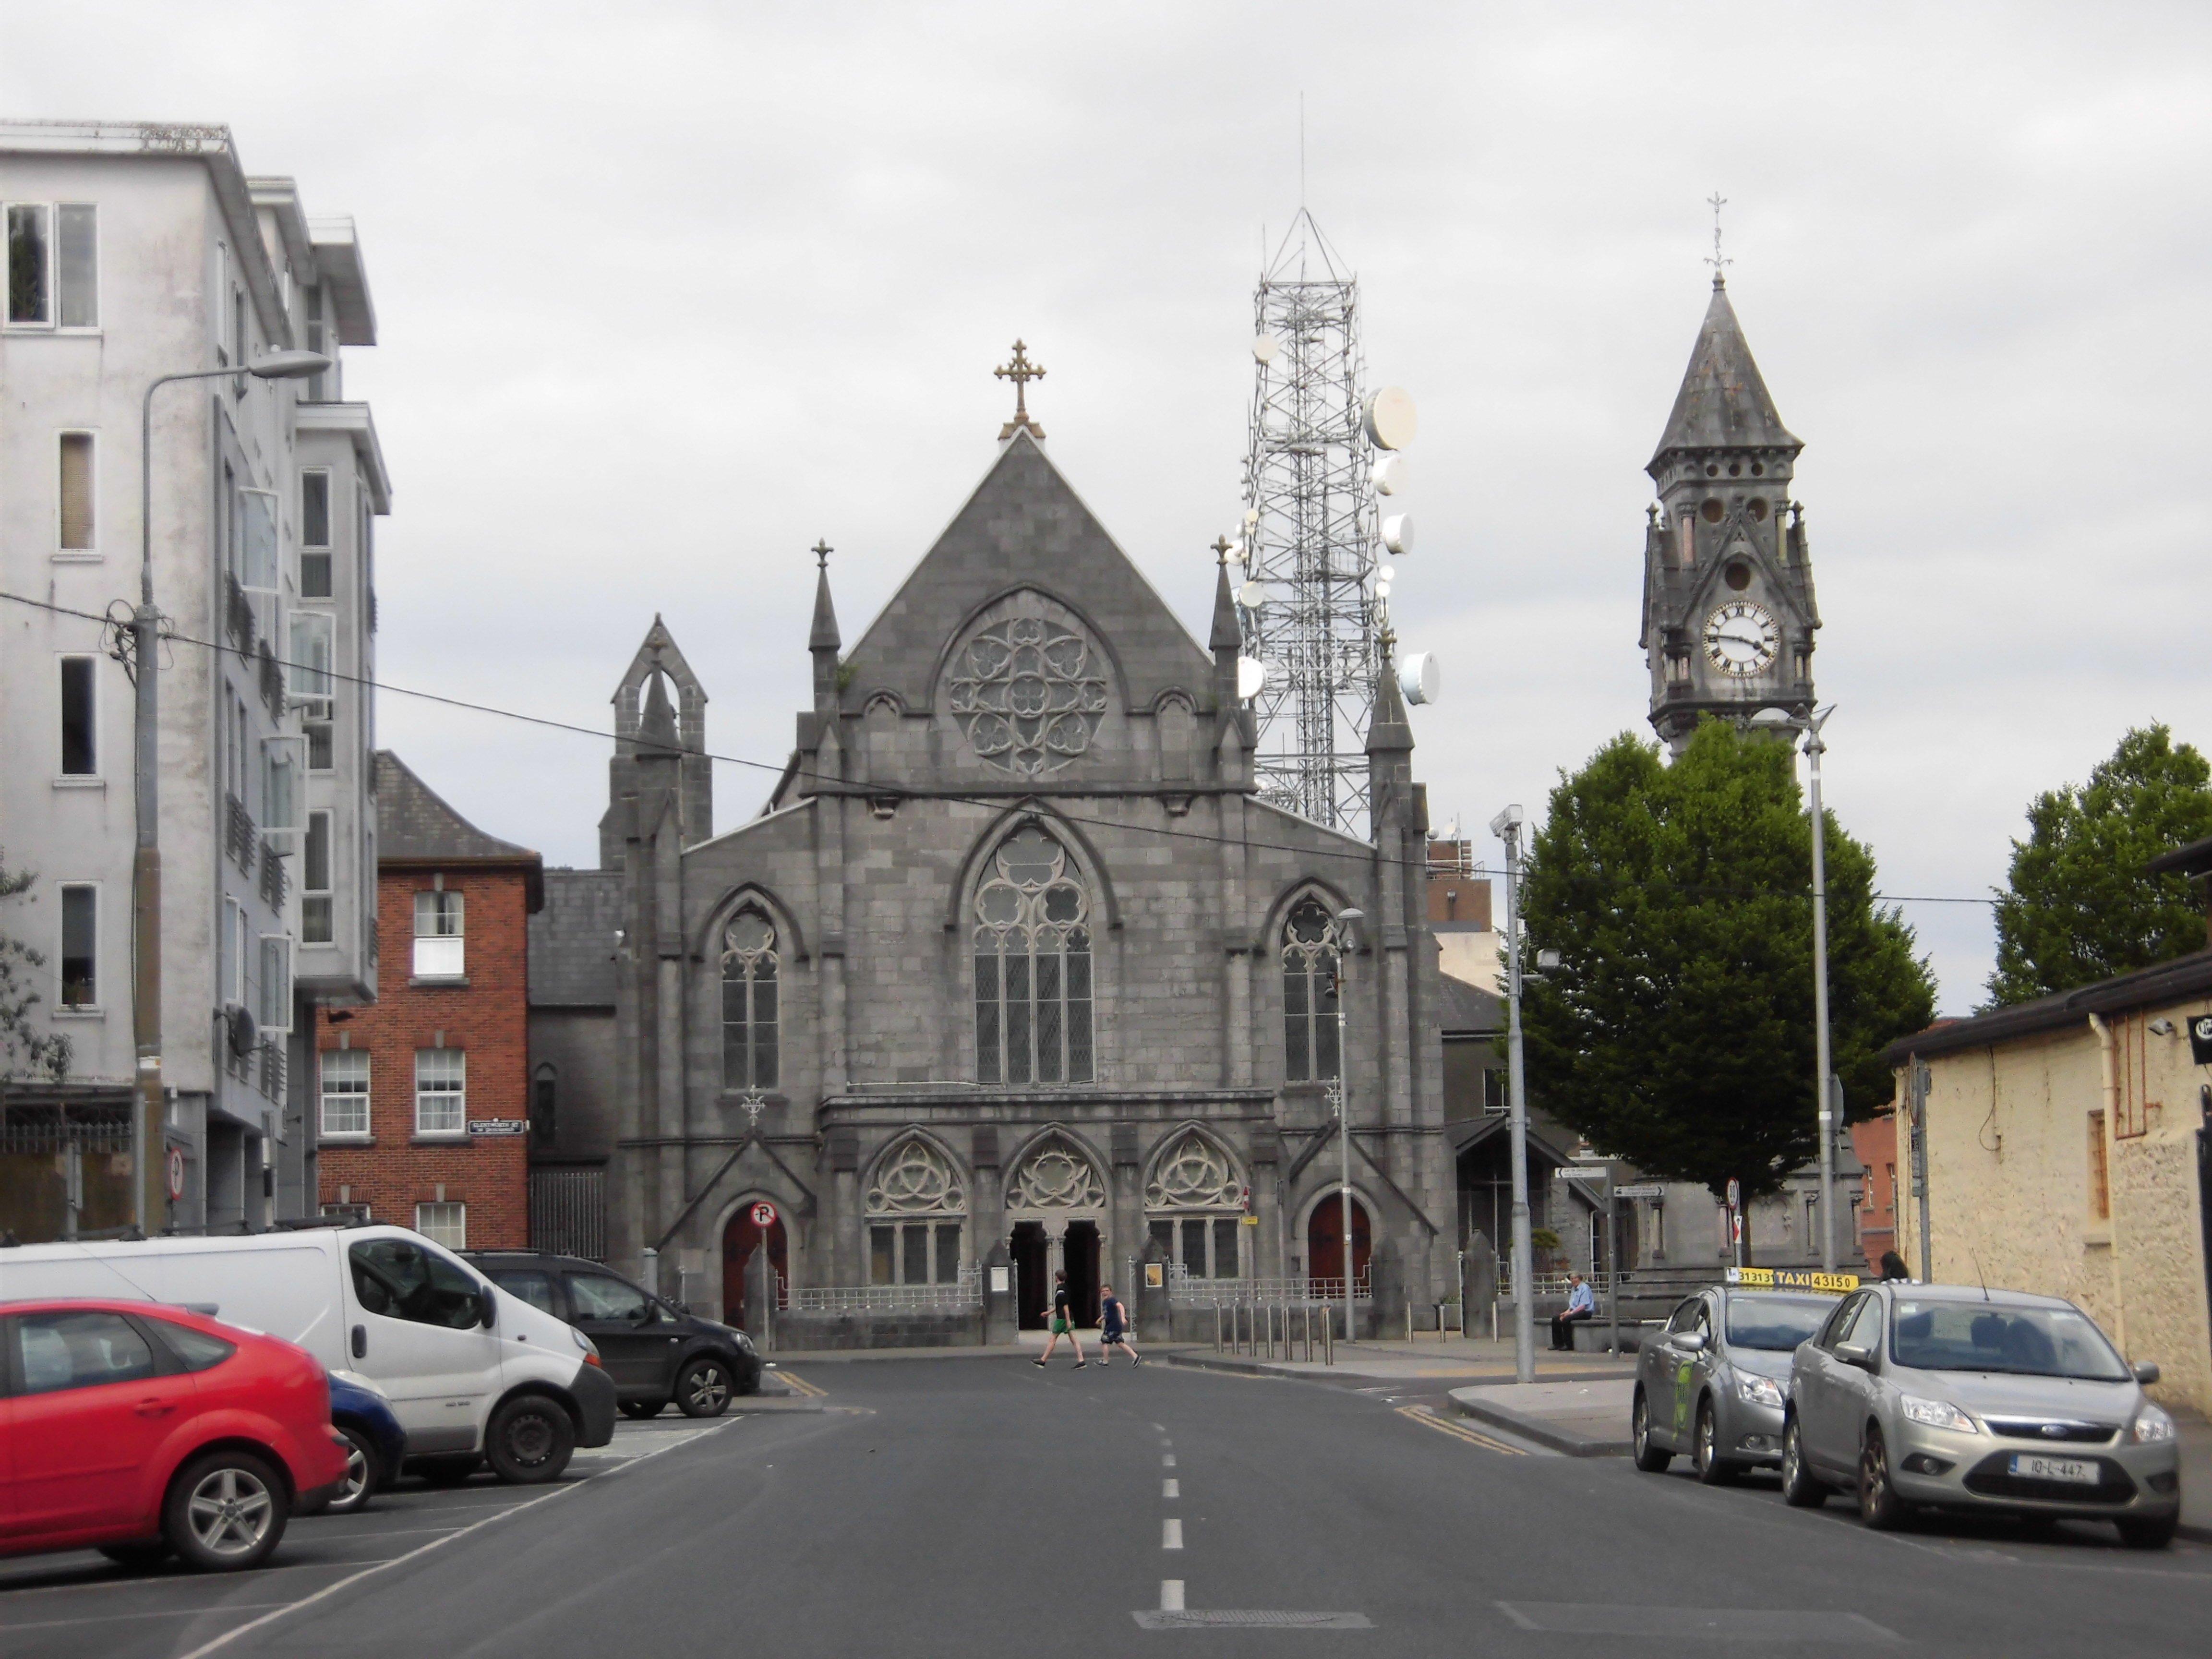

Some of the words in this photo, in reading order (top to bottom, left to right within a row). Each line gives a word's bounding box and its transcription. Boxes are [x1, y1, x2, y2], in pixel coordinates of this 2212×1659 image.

[1739, 1271, 1775, 1282] 313131
[1777, 1272, 1810, 1286] TAXI
[1814, 1275, 1851, 1288] 43150
